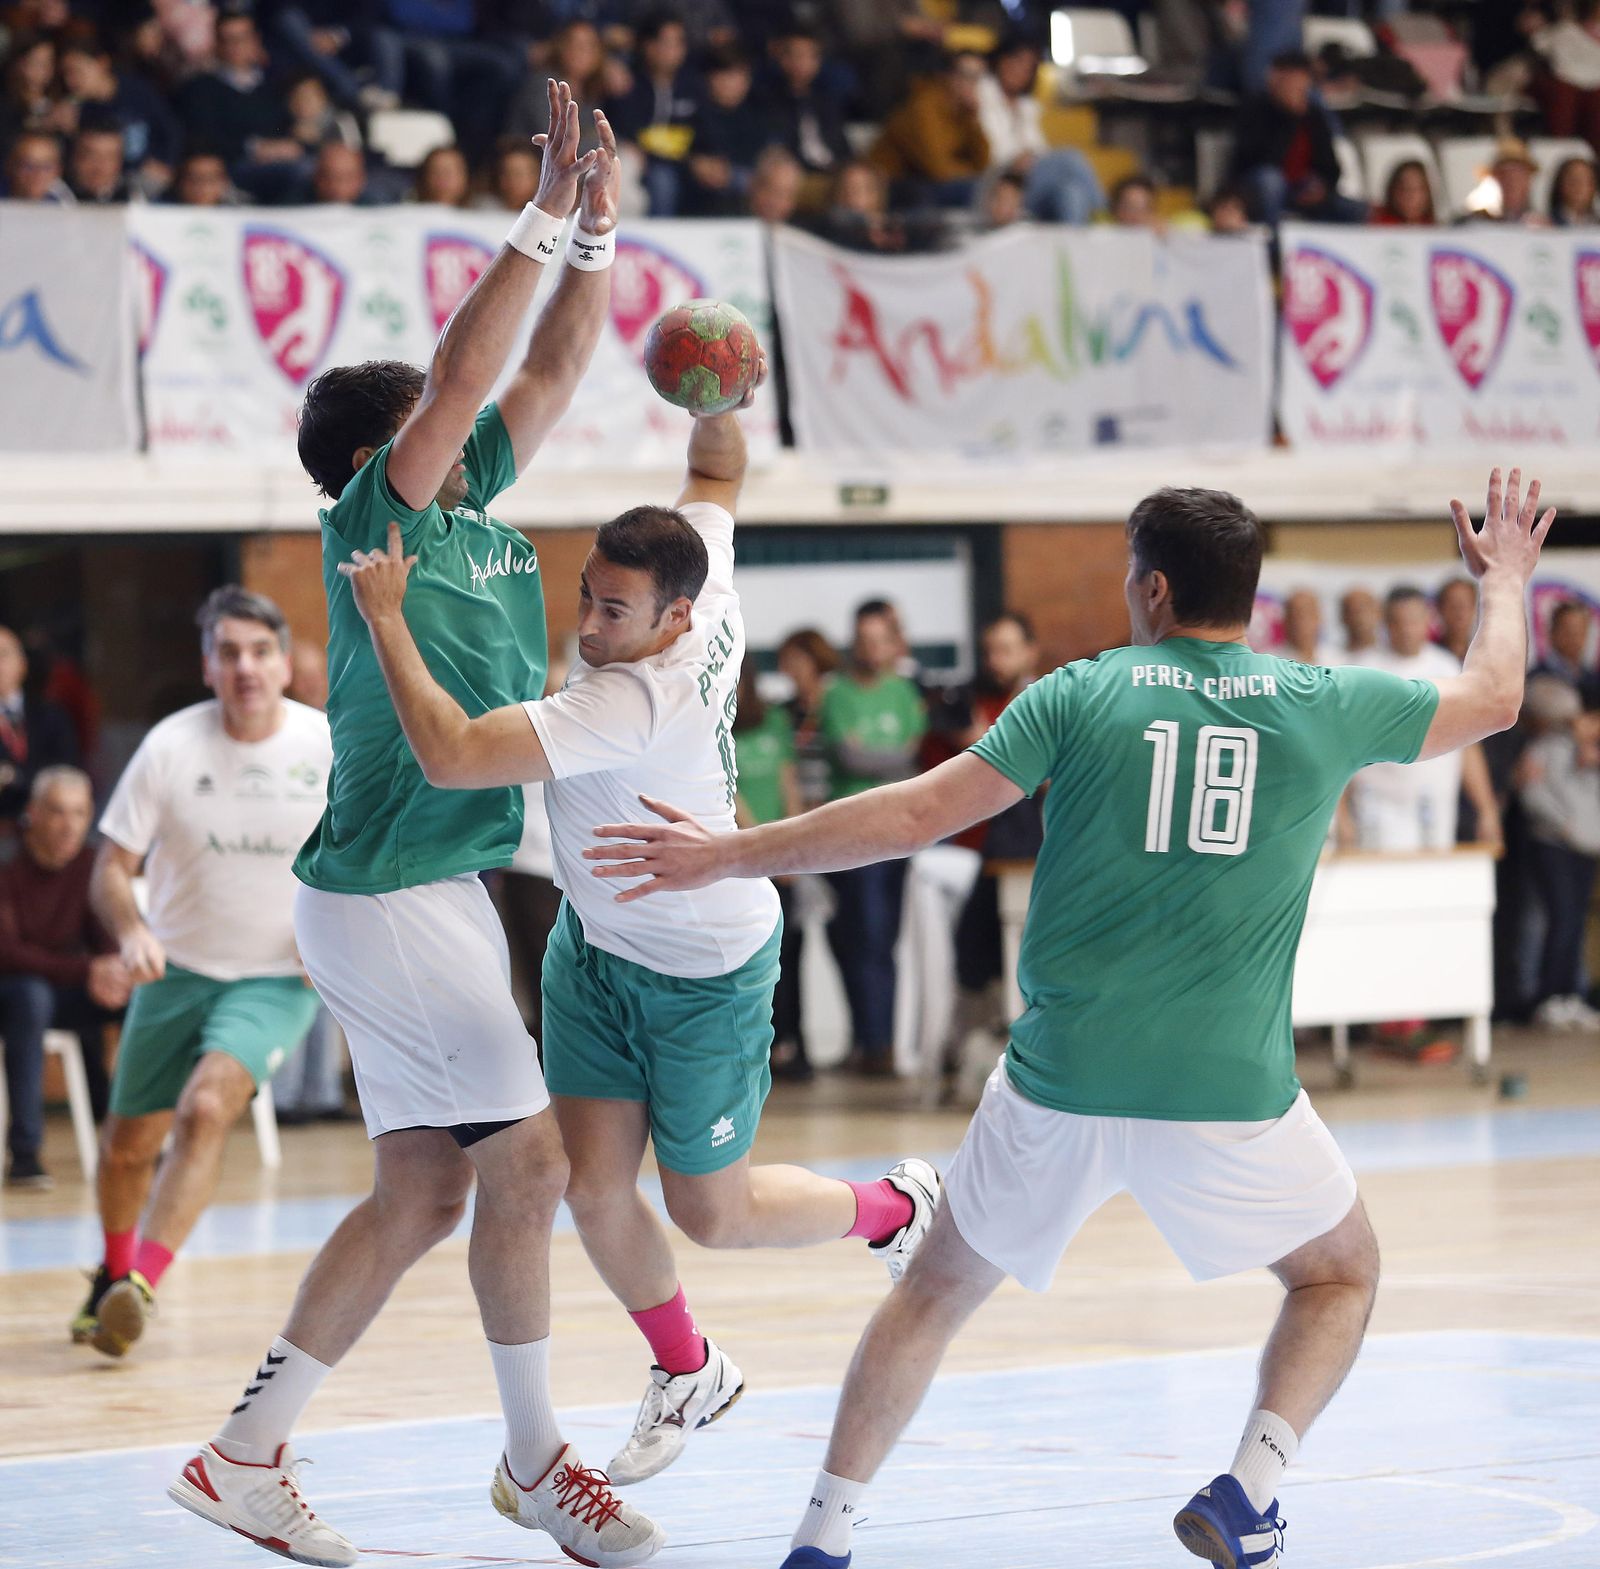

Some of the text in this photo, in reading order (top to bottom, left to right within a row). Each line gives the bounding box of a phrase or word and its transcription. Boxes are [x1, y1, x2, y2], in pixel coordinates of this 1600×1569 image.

[1131, 664, 1278, 700] PEREZ CANCA
[1143, 719, 1259, 856] 18
[711, 1130, 736, 1148] luanvi
